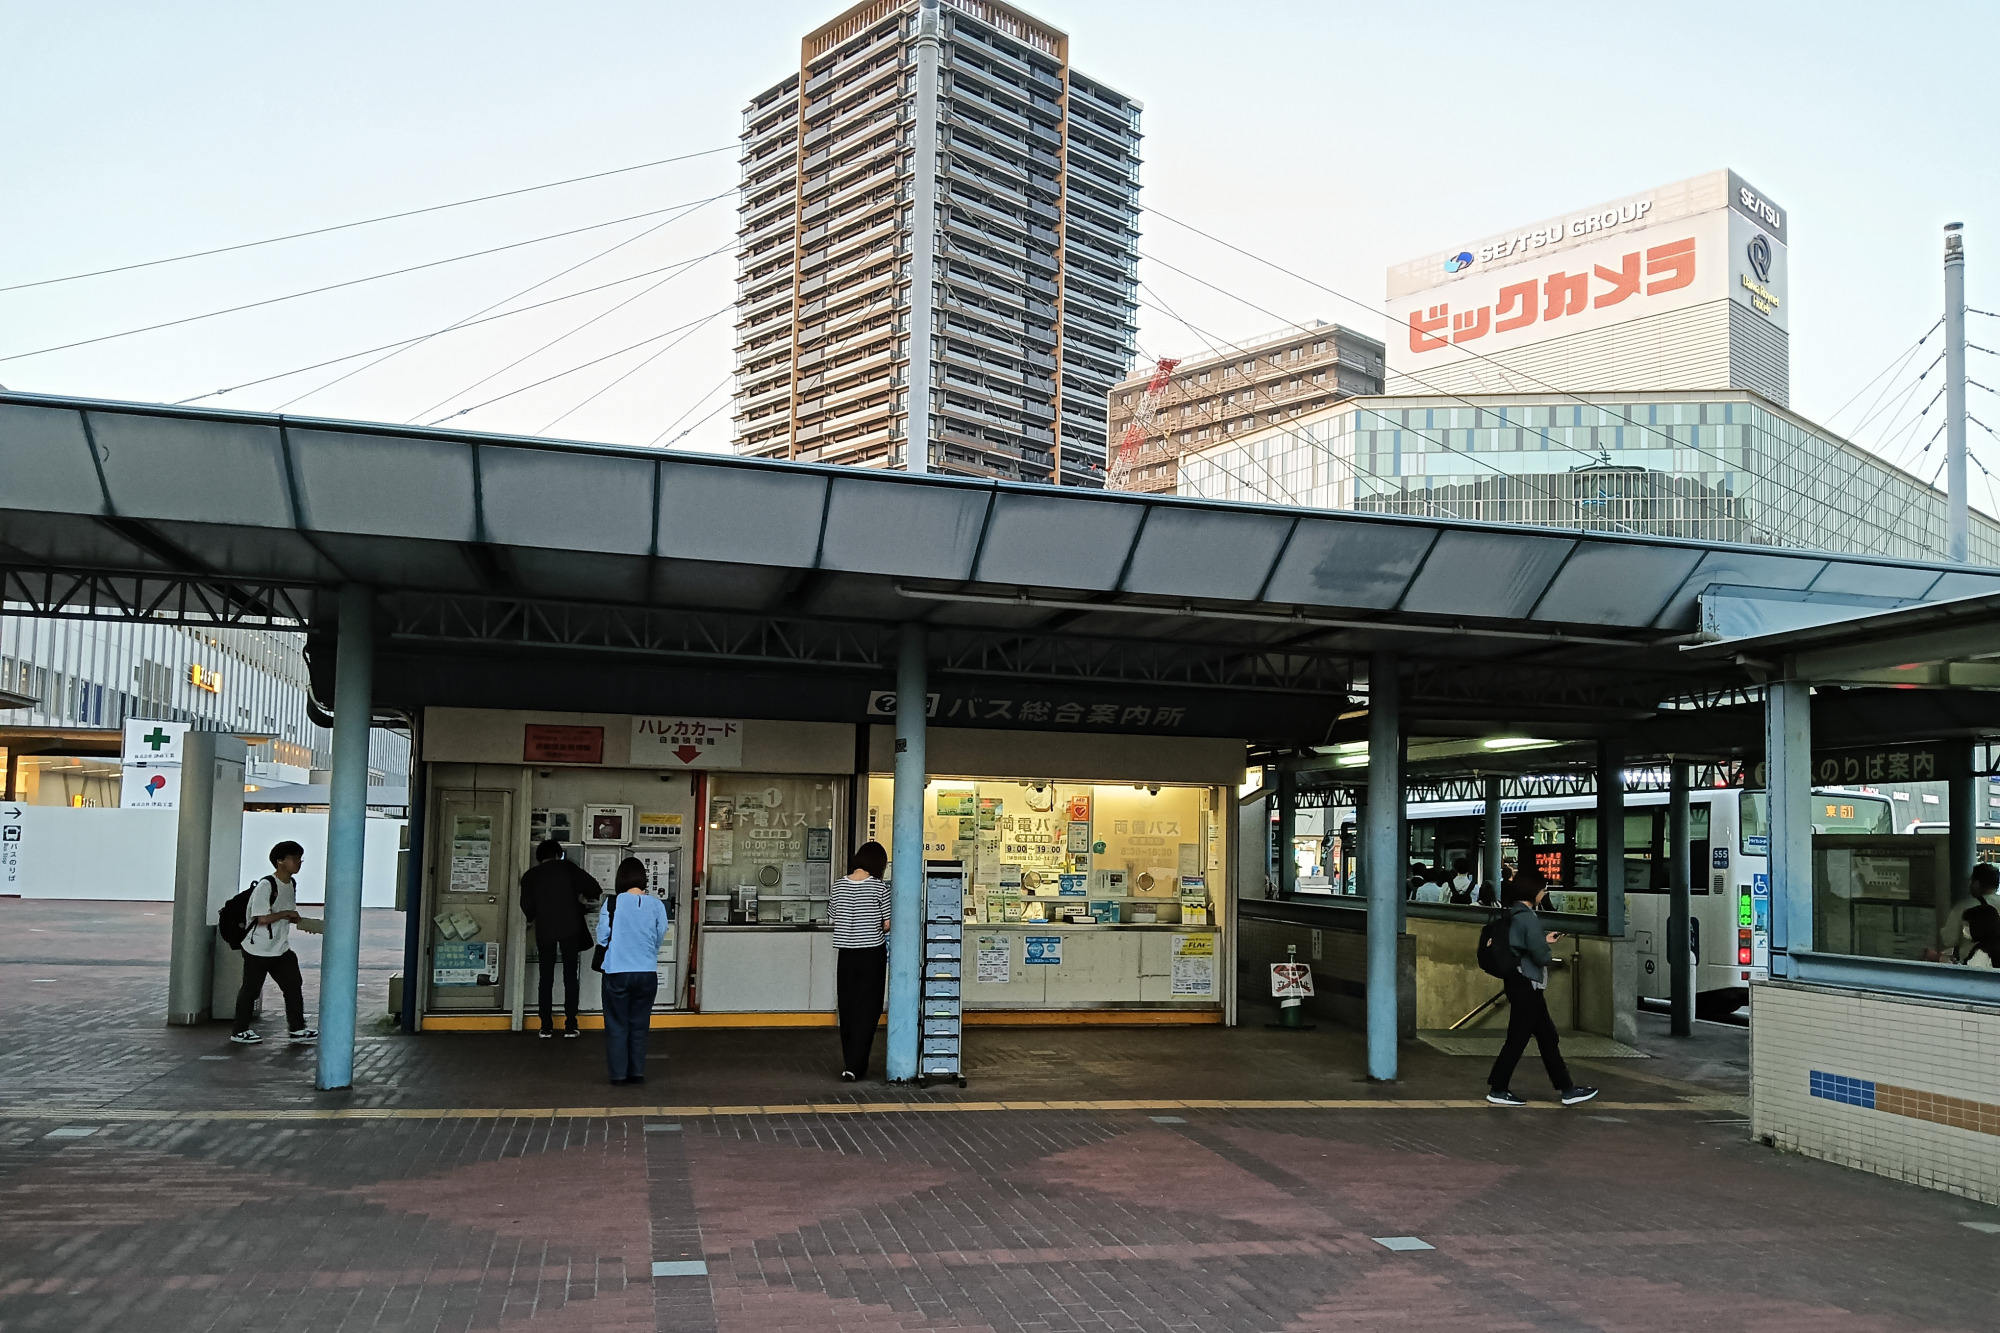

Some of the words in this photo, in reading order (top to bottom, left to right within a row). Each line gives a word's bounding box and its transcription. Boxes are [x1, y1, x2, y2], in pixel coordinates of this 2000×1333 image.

[1568, 200, 1652, 238] GROUP
[1409, 236, 1696, 354] ビックカメラ
[1751, 295, 1772, 316] Hotels
[947, 697, 1187, 728] バス総合案内所
[638, 719, 737, 738] ハレカカード
[1811, 750, 1934, 783] のりば案内
[734, 811, 808, 827] 下電バス
[1826, 805, 1837, 817] 東
[1841, 806, 1854, 818] 51
[1113, 819, 1179, 835] 両備バス
[8, 843, 18, 882] バスのりば
[1714, 850, 1728, 859] 555
